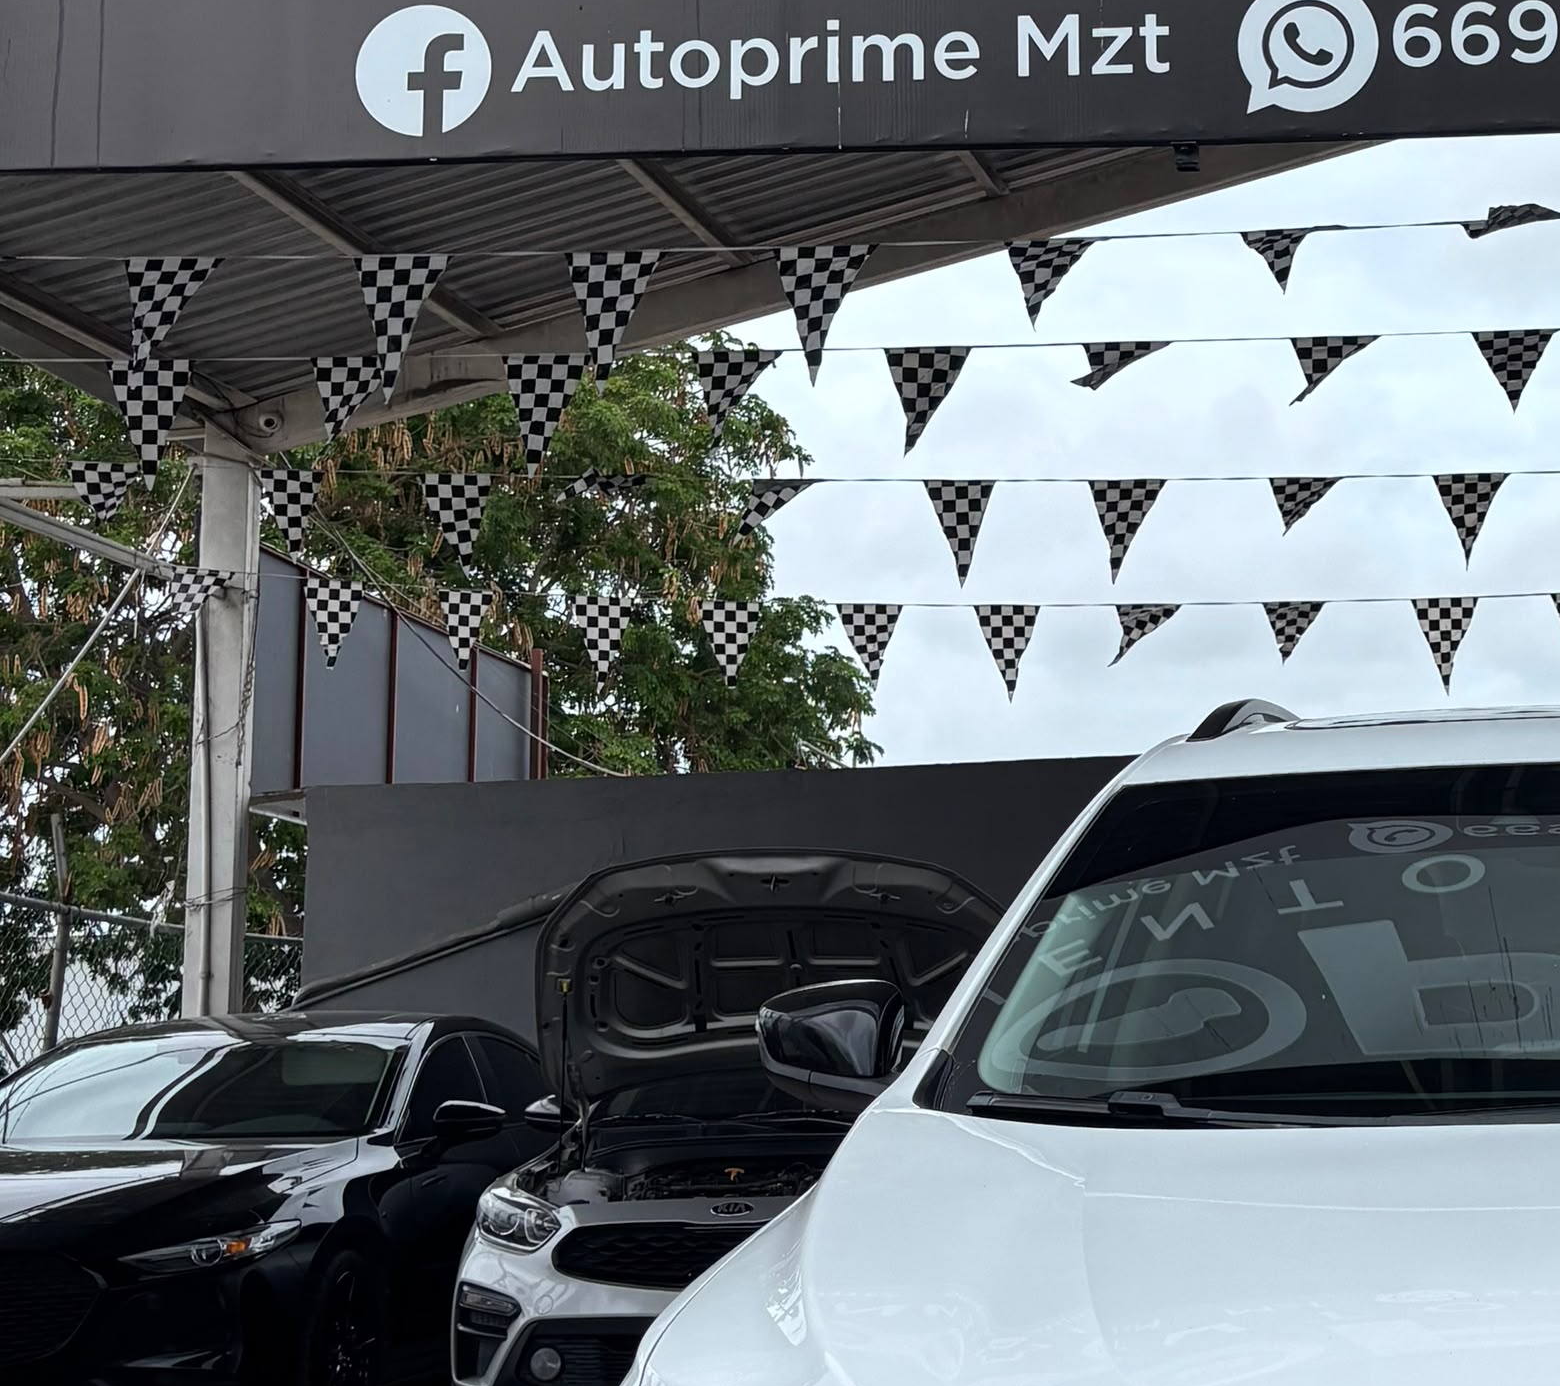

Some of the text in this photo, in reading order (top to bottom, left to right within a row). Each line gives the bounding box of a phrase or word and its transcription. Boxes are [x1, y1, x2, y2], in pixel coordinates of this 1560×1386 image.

[511, 18, 980, 100] Autoprime
[1015, 12, 1171, 78] Mzt
[1392, 0, 1559, 69] 669
[717, 1203, 747, 1213] KIA
